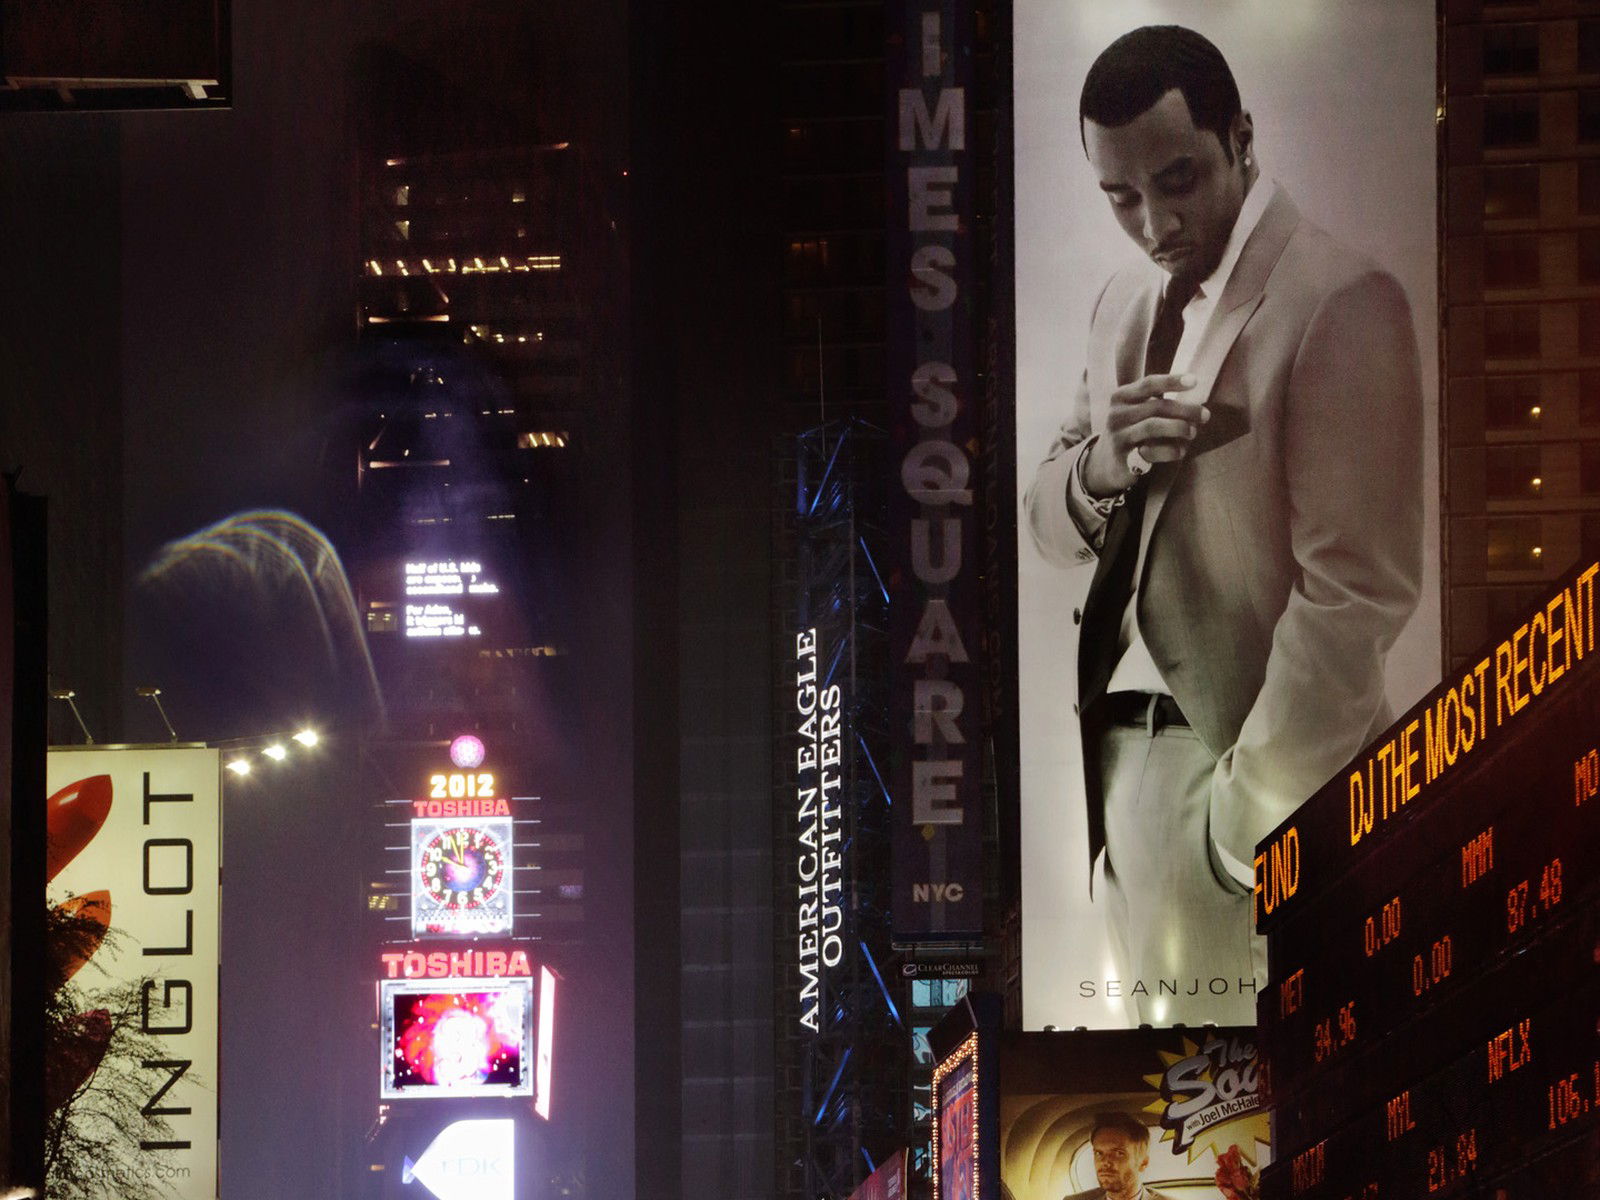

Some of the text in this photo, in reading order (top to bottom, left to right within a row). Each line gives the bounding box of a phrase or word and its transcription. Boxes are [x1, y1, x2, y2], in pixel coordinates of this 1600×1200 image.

[899, 361, 975, 827] SQUARE
[1349, 758, 1375, 847] DJ
[1377, 719, 1421, 820] THE
[1425, 656, 1491, 785] MOST
[1496, 561, 1600, 727] RECENT
[413, 800, 510, 817] TOSHIBA
[430, 774, 494, 799] 2012
[796, 626, 820, 1034] AMERICAN EAGLE
[820, 684, 843, 968] OUTFITTERS
[912, 881, 963, 904] NYC
[140, 771, 194, 1151] INGLOT
[381, 951, 531, 978] TOSHIBA
[1487, 1018, 1532, 1084] NFLX
[1200, 1107, 1222, 1126] Joel
